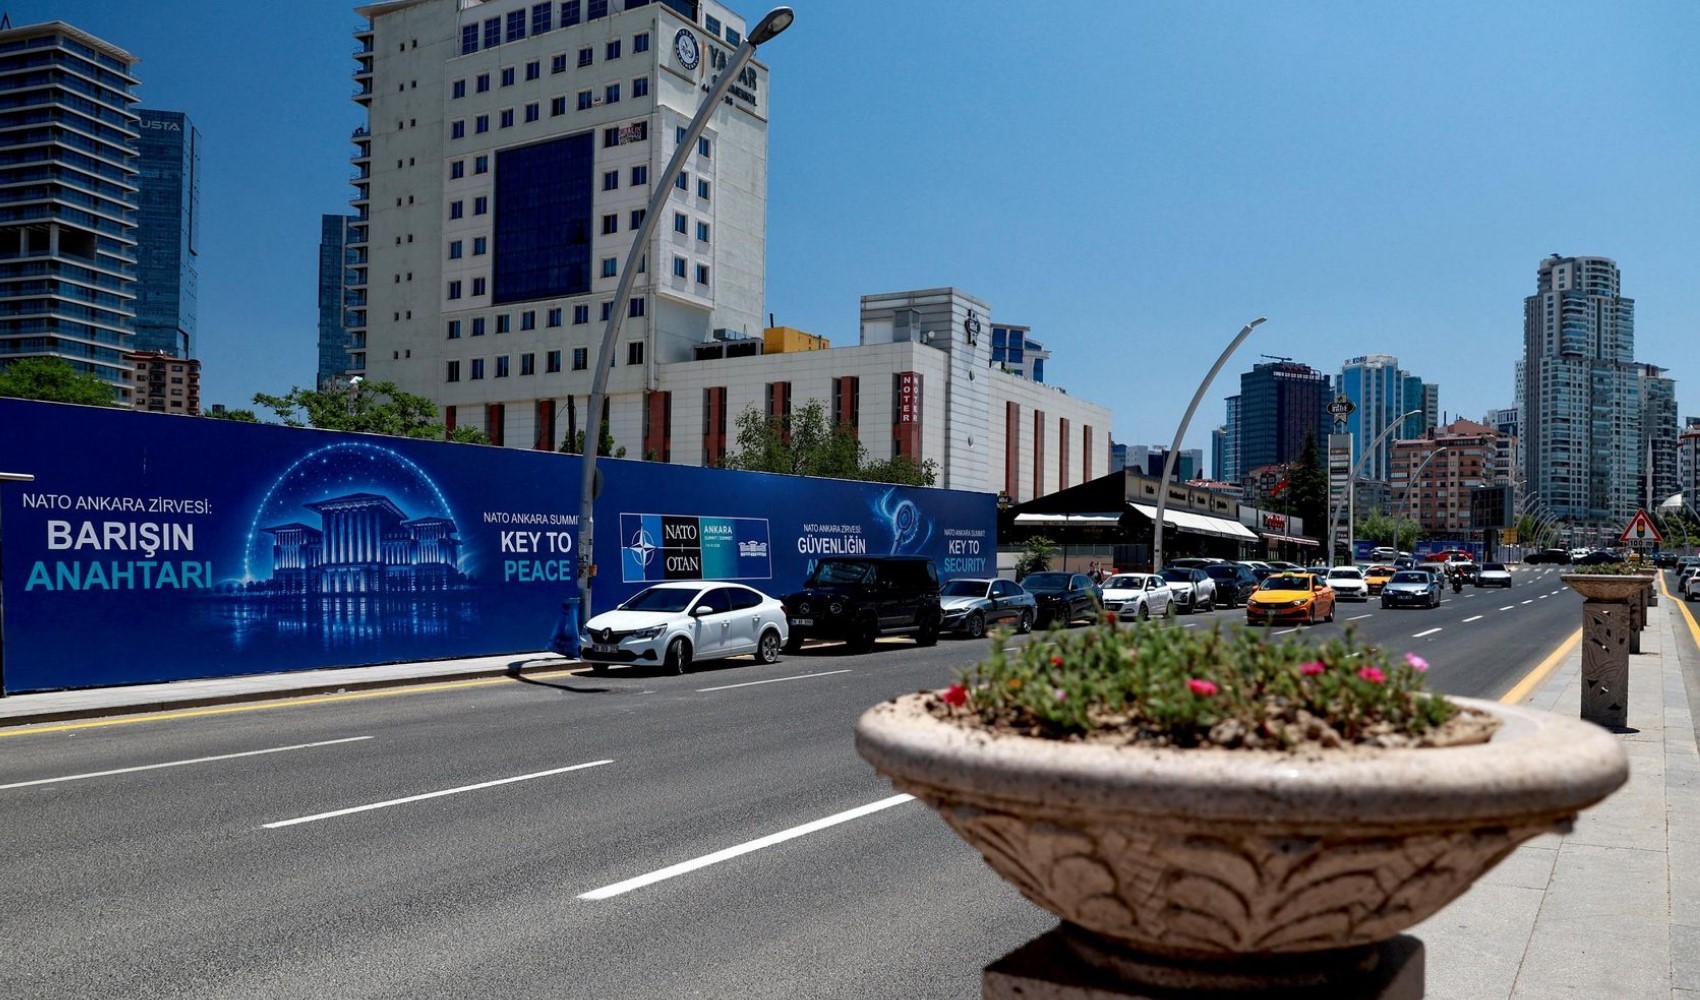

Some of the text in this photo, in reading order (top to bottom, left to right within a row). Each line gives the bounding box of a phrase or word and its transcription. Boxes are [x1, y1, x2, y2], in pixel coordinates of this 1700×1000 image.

[708, 44, 757, 91] YAAR
[903, 376, 911, 421] NOTER
[22, 493, 212, 514] NATO ANKARA ZİRVESİ:
[483, 512, 580, 525] NATO ANKARA SUMMI
[803, 524, 819, 532] NATO
[819, 524, 841, 533] ANKARA
[47, 520, 194, 558] BARIŞIN
[665, 524, 697, 540] NATO
[703, 525, 733, 534] ANKARA
[501, 531, 572, 553] KEY TO
[797, 534, 866, 554] GÜVENLİĞİN
[949, 540, 980, 555] KEY TO
[504, 560, 571, 582] PEACE
[666, 556, 699, 571] OTAN
[944, 557, 986, 572] SECURITY
[24, 561, 212, 591] ANAHTARI
